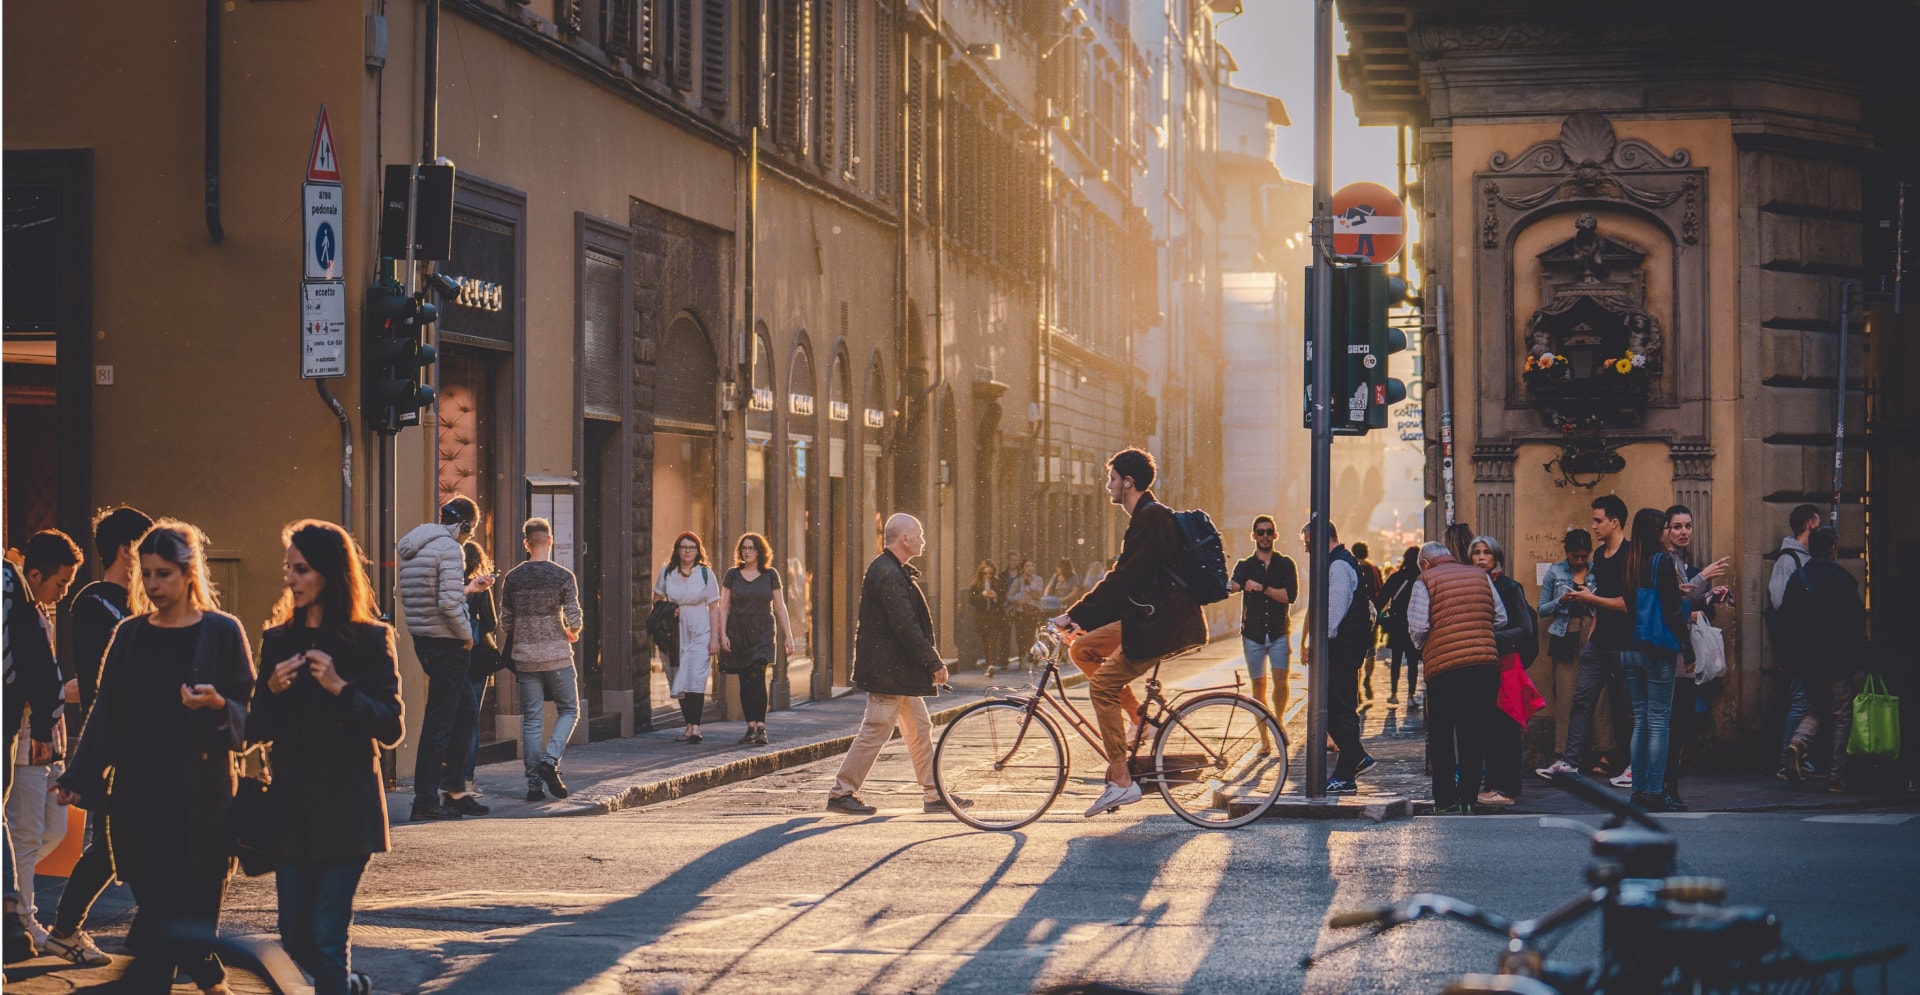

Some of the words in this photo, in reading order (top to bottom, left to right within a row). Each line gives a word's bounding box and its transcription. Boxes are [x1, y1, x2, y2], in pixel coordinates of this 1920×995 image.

[318, 190, 332, 200] area
[311, 203, 338, 216] pedonale
[315, 287, 336, 297] eccetto
[98, 369, 110, 381] 81
